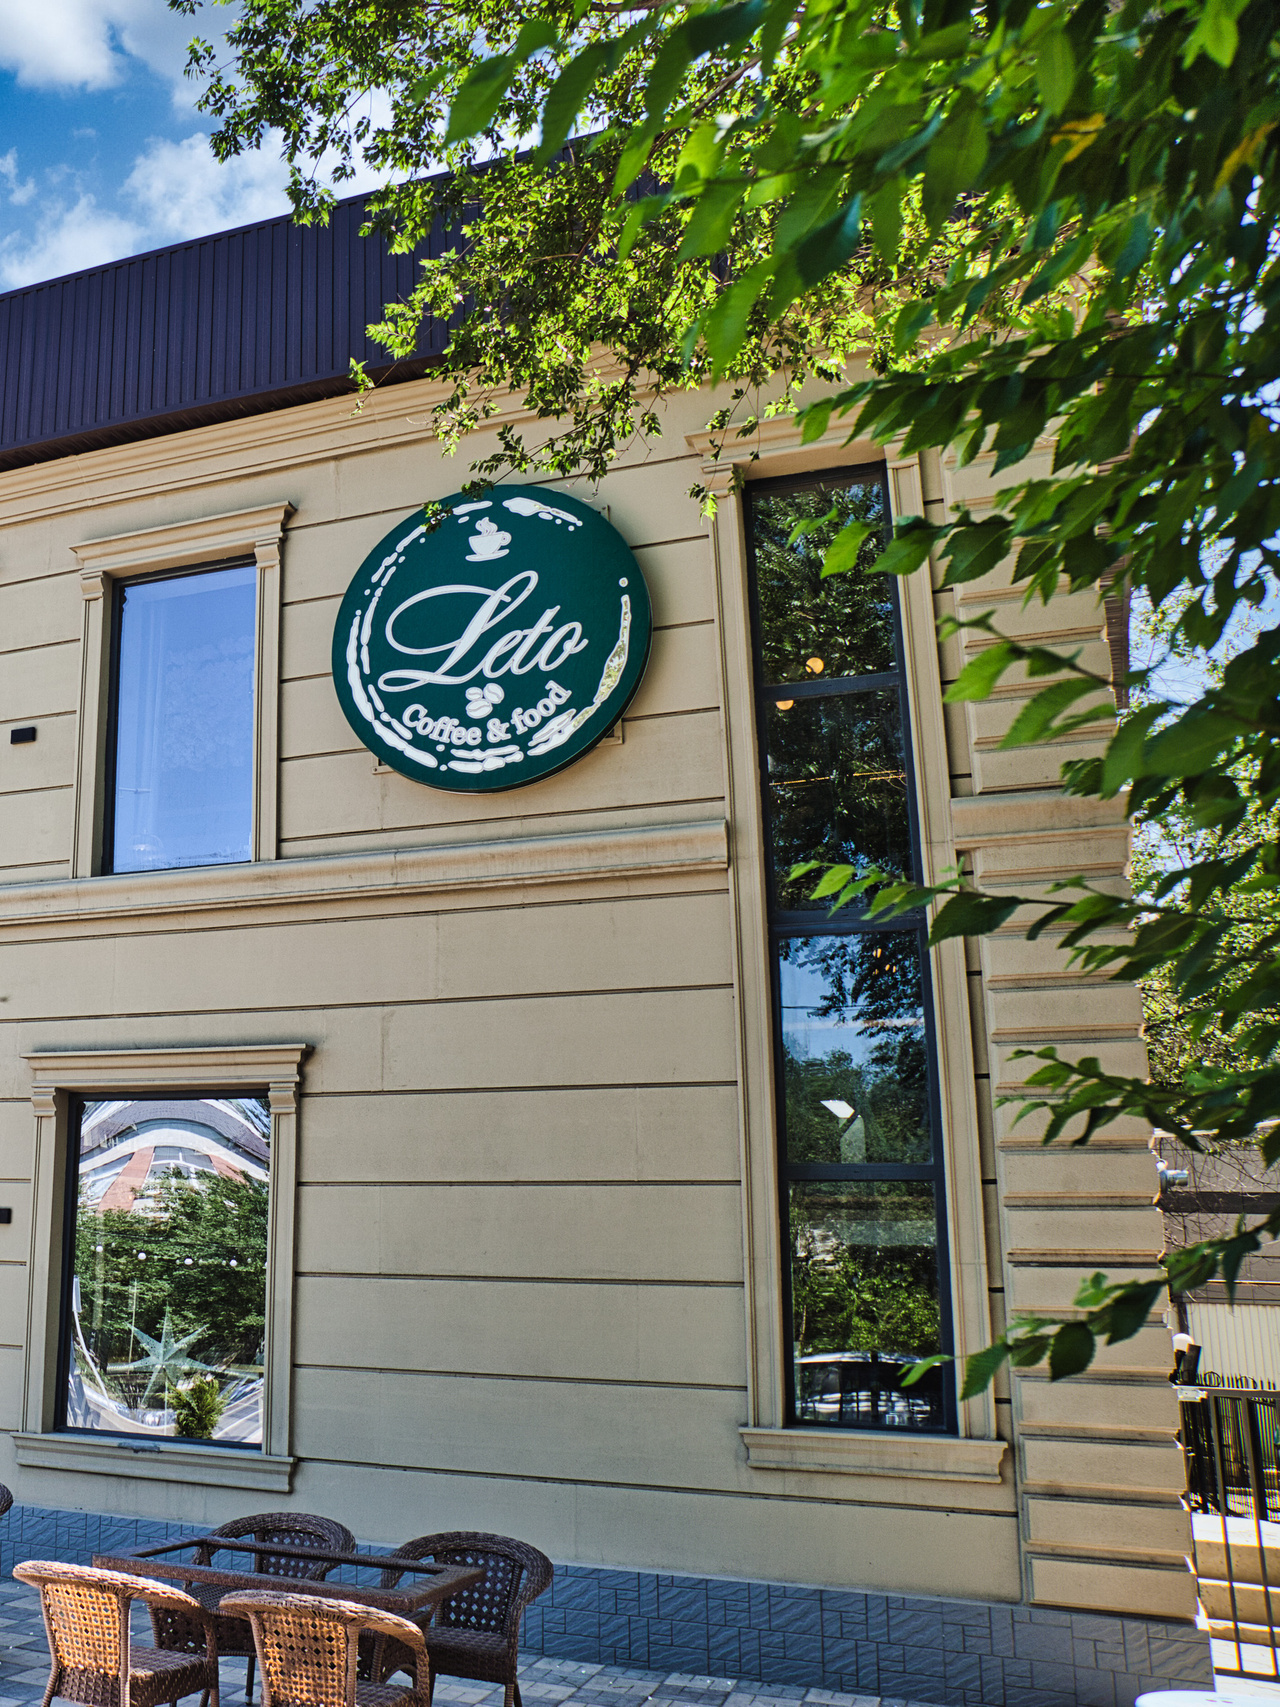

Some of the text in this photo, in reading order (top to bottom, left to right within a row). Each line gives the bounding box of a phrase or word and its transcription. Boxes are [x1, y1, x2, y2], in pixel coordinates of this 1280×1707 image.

[378, 570, 588, 692] Leto
[402, 680, 572, 746] Coffee & food
